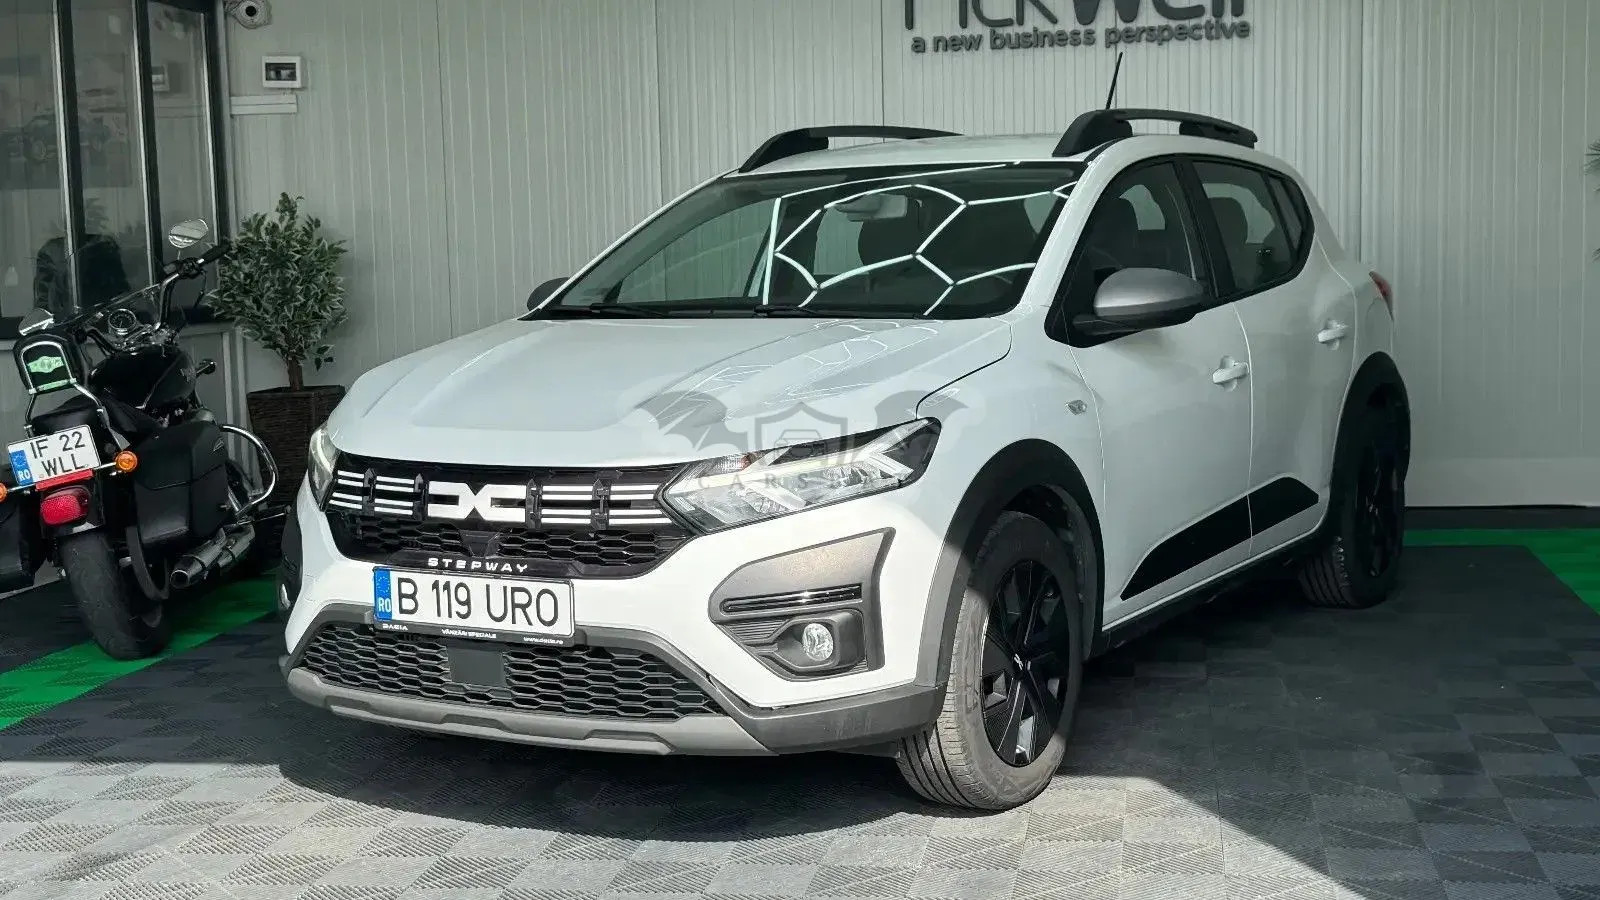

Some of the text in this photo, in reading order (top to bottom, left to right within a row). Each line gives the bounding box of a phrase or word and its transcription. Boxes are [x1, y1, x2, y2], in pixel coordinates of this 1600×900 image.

[911, 19, 1251, 53] a new business perspective
[30, 432, 85, 460] IF 22
[17, 469, 31, 482] RO
[42, 454, 84, 476] WLL
[427, 557, 528, 573] STEPWAY
[378, 597, 391, 613] RO
[397, 577, 559, 627] B 119 URO
